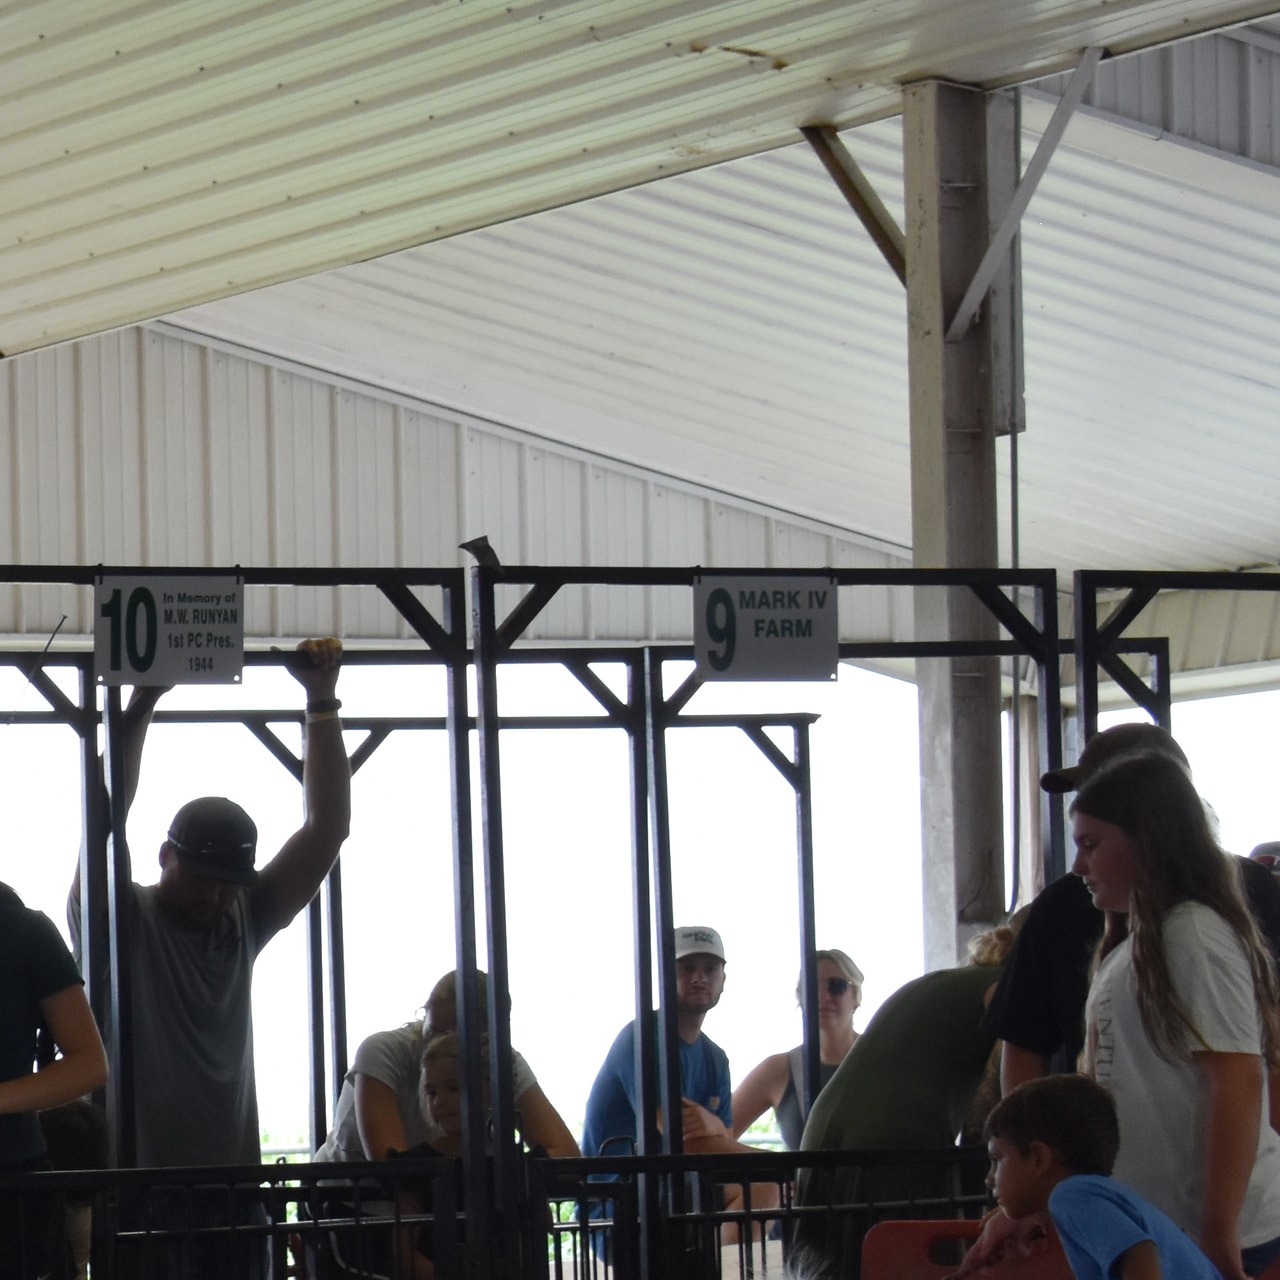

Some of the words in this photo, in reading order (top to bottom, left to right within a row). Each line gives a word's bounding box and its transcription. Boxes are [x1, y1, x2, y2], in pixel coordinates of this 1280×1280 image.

[163, 593, 173, 603] In
[178, 592, 220, 605] Memory
[225, 592, 236, 603] of
[739, 590, 801, 609] MARK
[808, 590, 827, 609] IV
[164, 609, 189, 624] M.W.
[193, 609, 237, 624] RUNYAN
[101, 586, 157, 673] 10
[706, 588, 736, 672] 9
[754, 619, 812, 637] FARM
[168, 634, 184, 648] 1st
[188, 633, 202, 648] PC
[207, 633, 234, 648] Pres.
[189, 657, 213, 671] 1944
